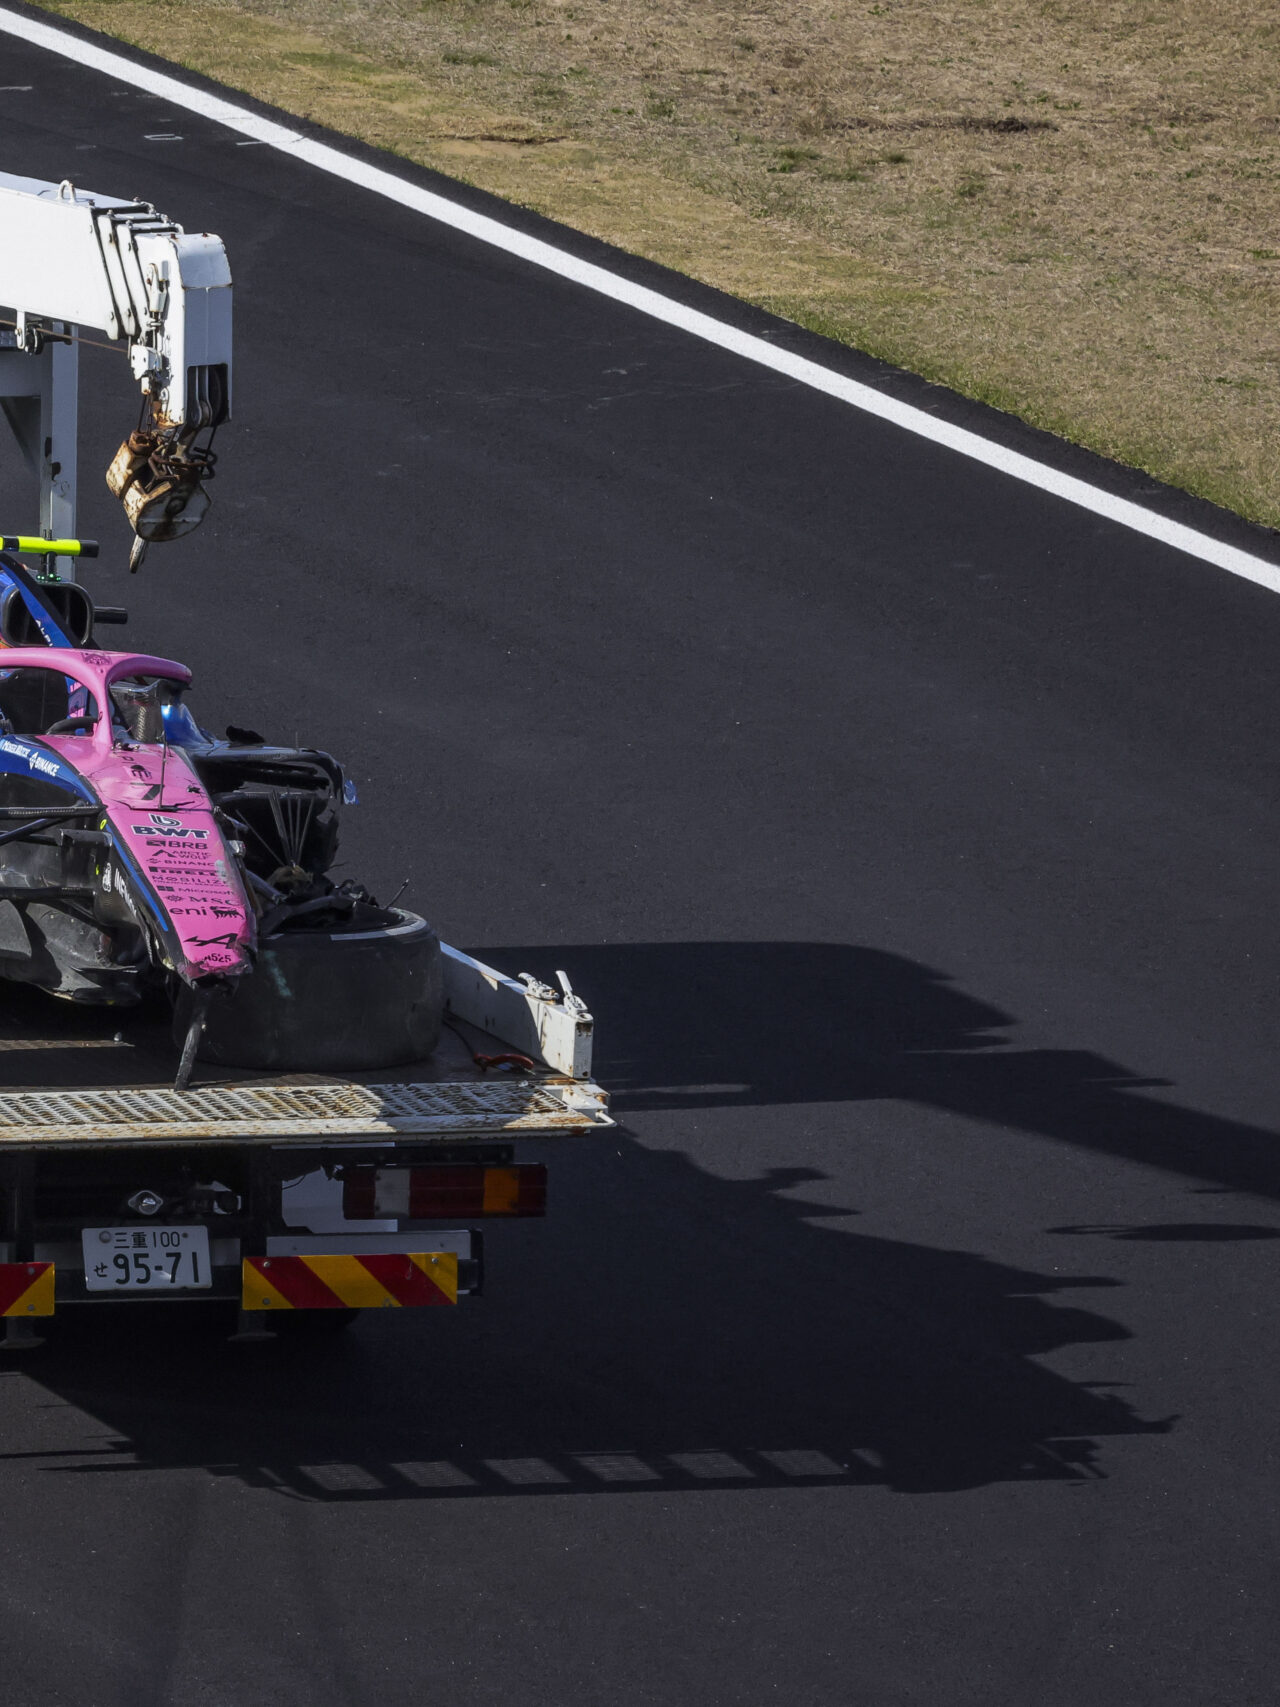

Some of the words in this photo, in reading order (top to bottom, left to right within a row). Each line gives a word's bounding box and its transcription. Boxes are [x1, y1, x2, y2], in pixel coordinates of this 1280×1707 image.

[34, 756, 60, 777] BINANCE
[131, 825, 210, 839] BWT
[168, 840, 208, 850] BRB
[169, 906, 208, 916] eni
[114, 1231, 148, 1249] 三重
[153, 1231, 181, 1248] 100
[93, 1262, 108, 1277] せ
[113, 1251, 200, 1285] 95-71
